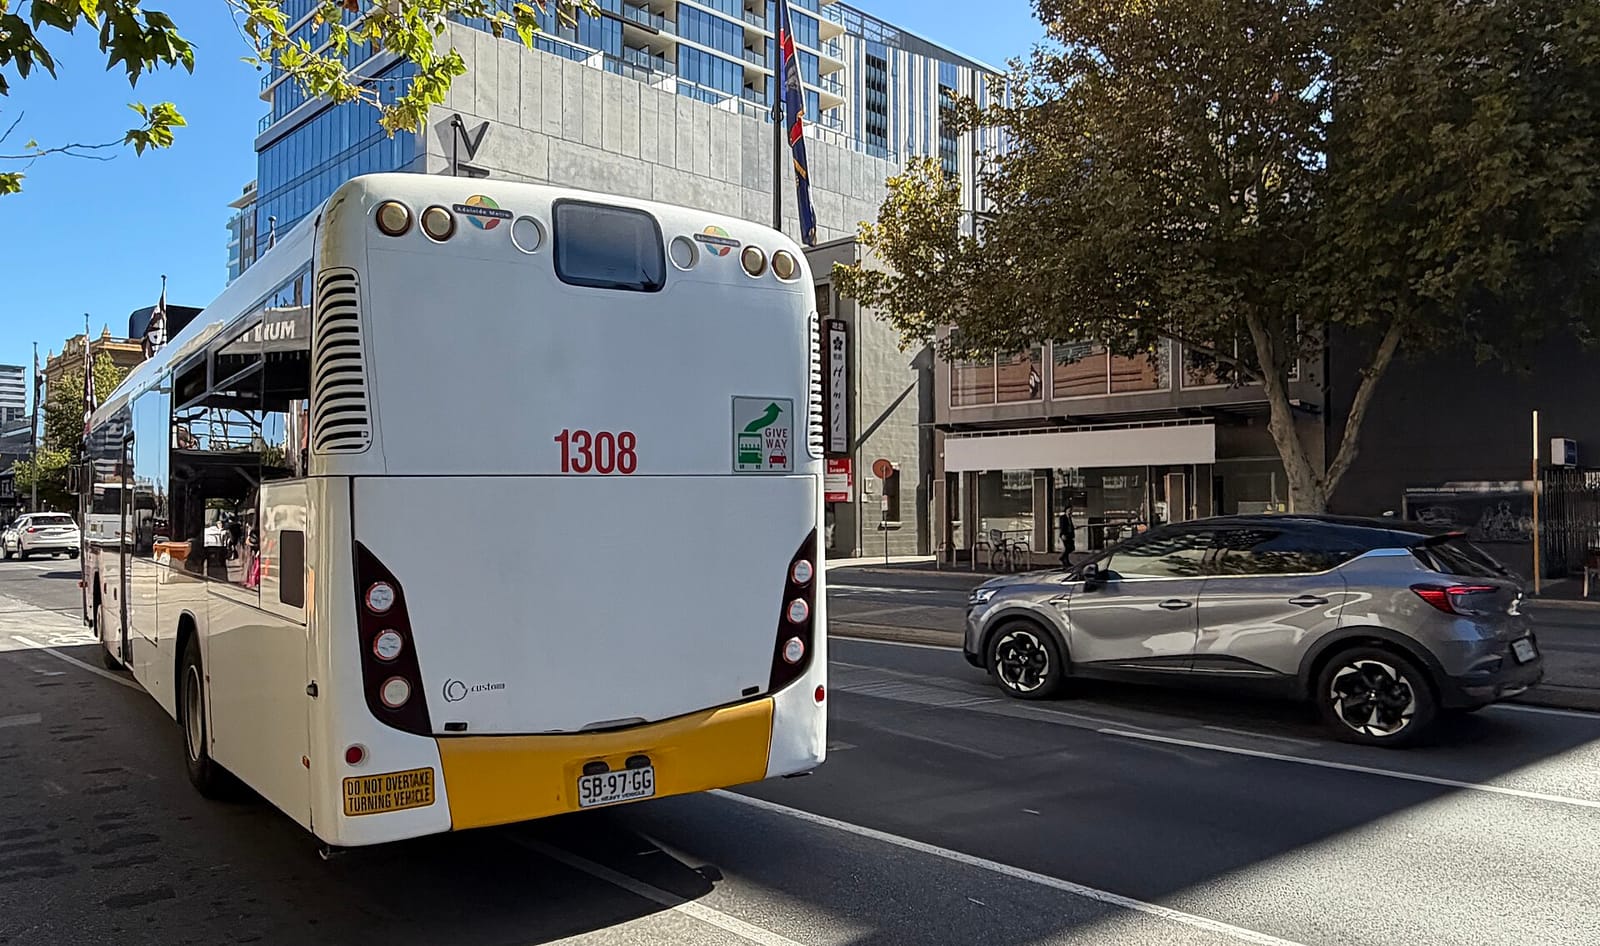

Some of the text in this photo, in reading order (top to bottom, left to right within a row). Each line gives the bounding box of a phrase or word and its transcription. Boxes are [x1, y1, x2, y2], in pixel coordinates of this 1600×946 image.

[765, 427, 788, 438] GIVE
[765, 438, 788, 449] WAY
[554, 429, 637, 475] 1308
[347, 771, 430, 796] DO NOT OVERTAKE
[347, 787, 430, 812] TURNING VEHICLE
